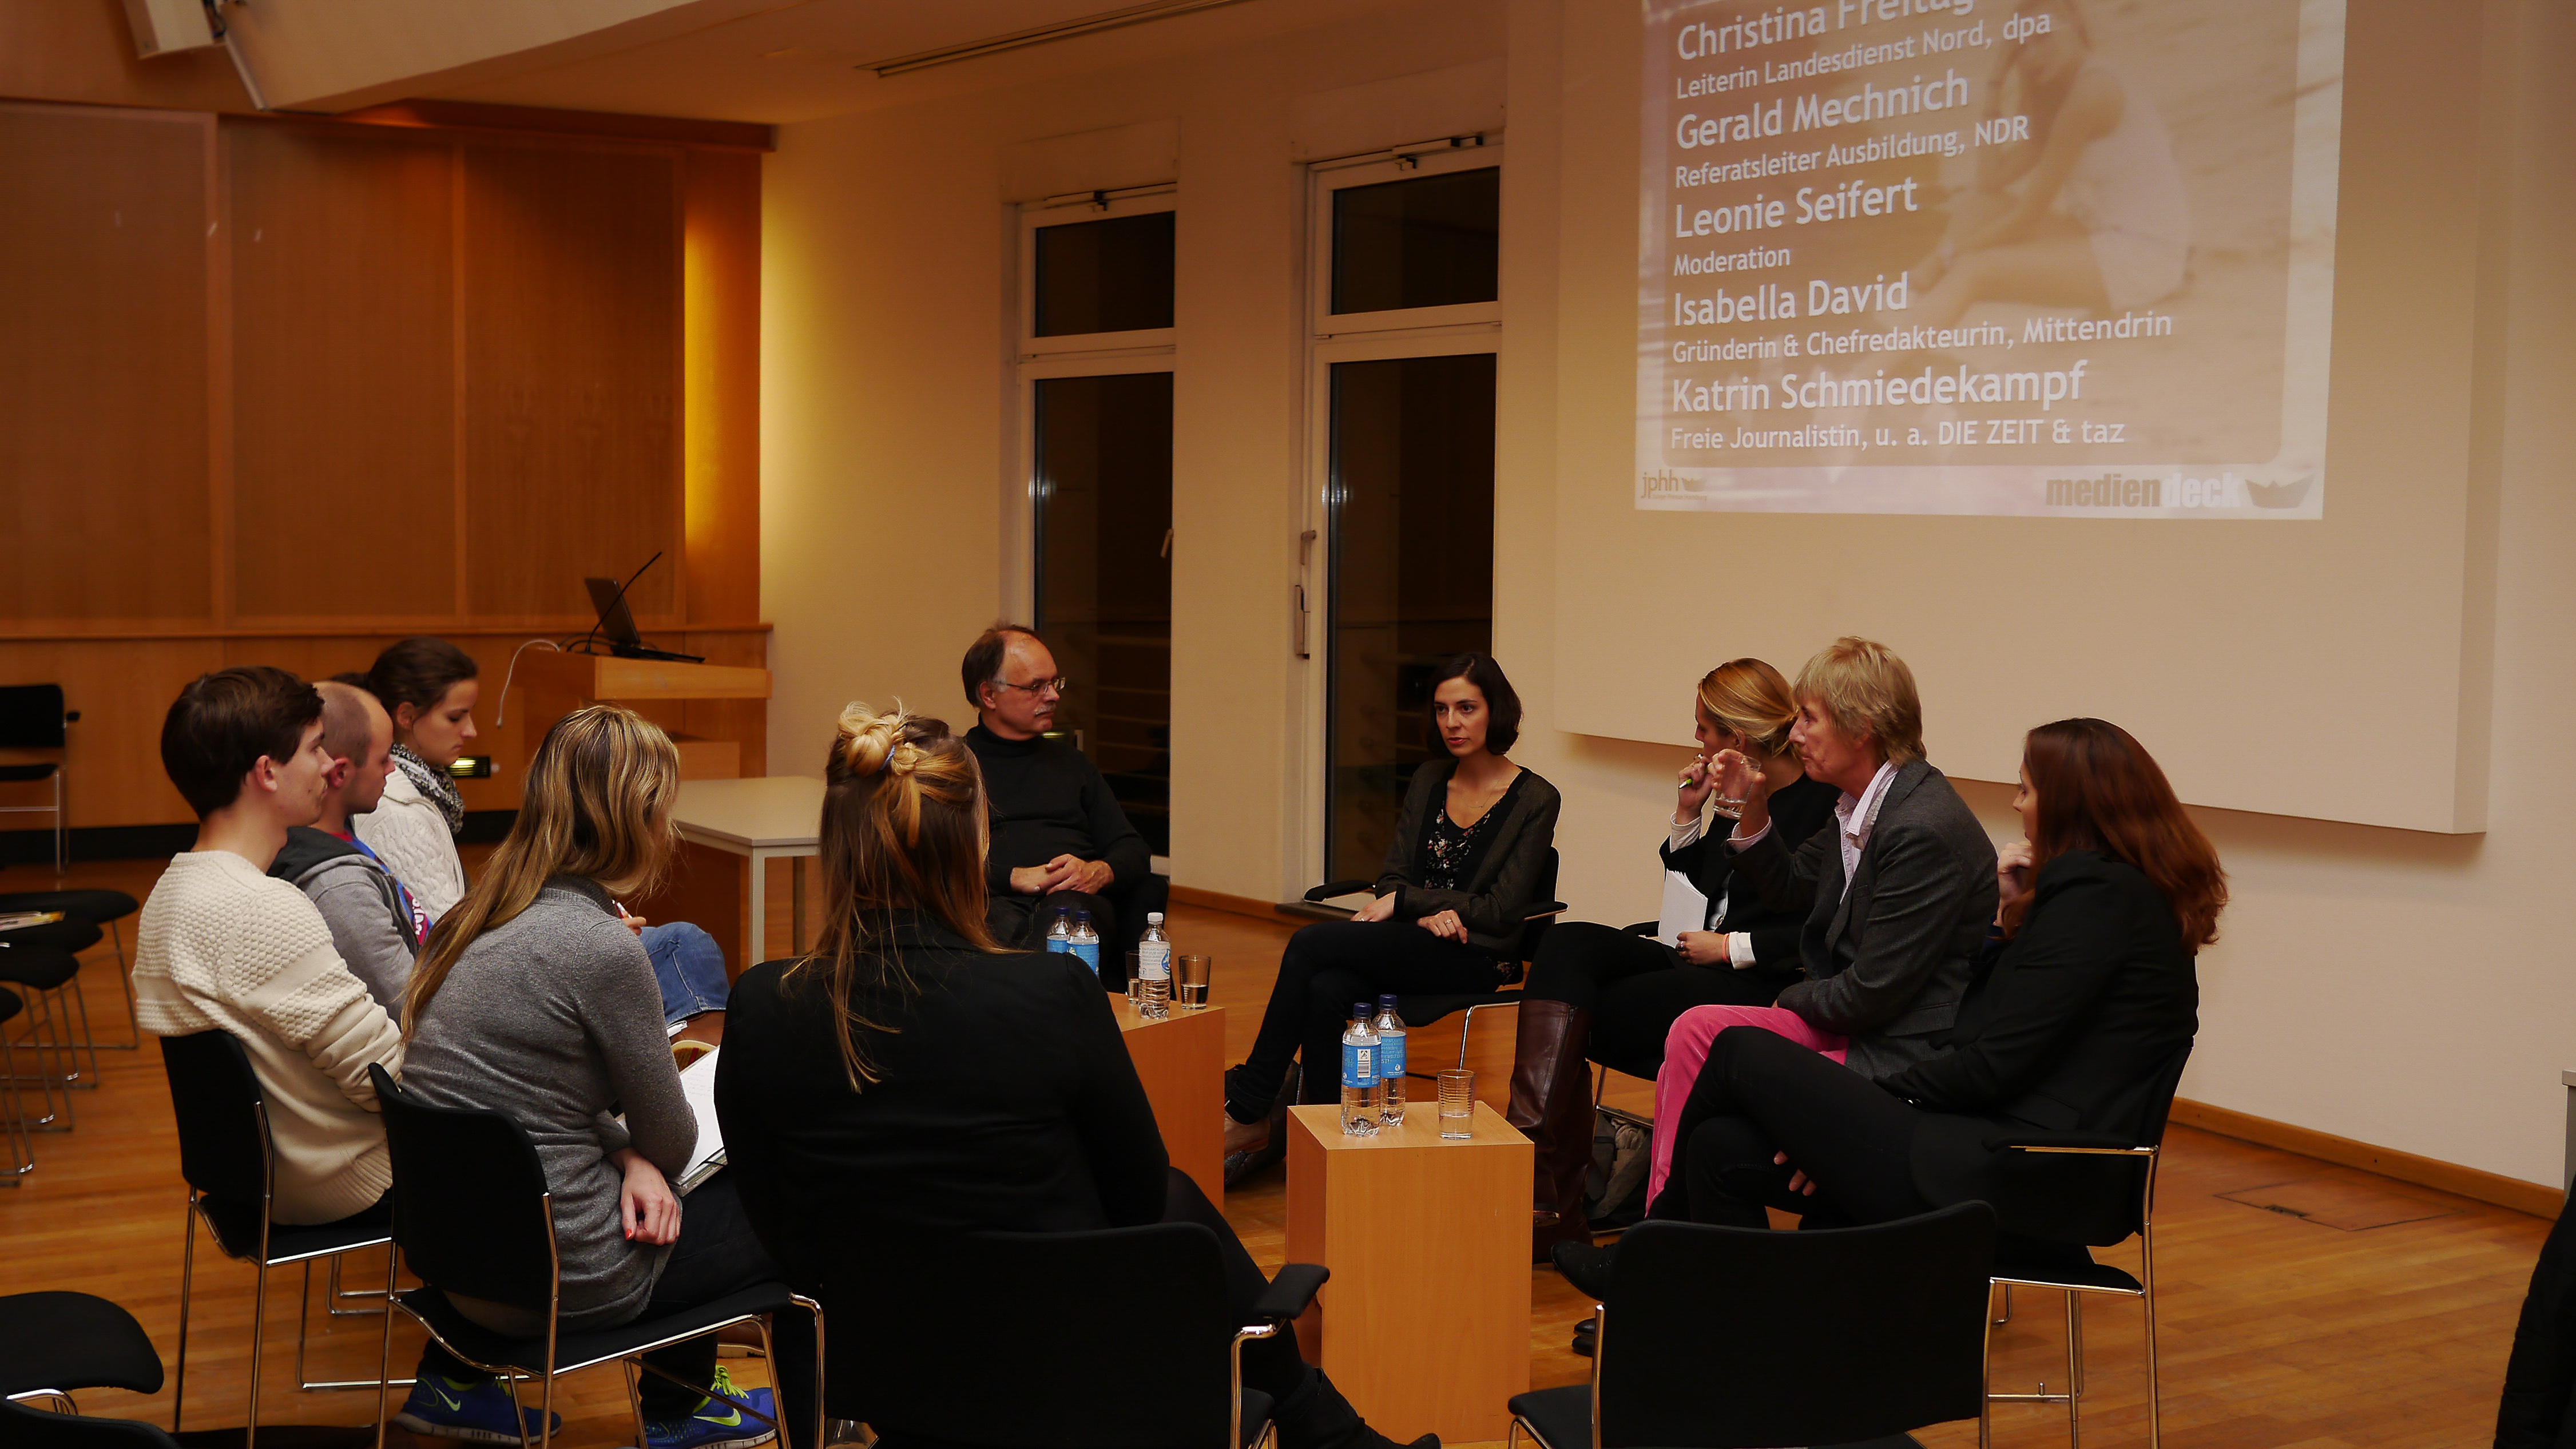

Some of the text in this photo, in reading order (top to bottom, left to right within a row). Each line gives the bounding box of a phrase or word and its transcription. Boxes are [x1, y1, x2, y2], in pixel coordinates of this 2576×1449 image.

[1677, 13, 2051, 99] Leiterin Landesdienst Nord, dpa
[1678, 7, 1826, 59] Christina
[1677, 68, 1968, 149] Gerald Mechnich
[1676, 116, 2030, 188] Referatsleiter Ausbildung, NDR
[1676, 177, 1918, 238] Leonie Seifert
[1673, 246, 1791, 276] Moderation
[1674, 271, 1908, 326] Isabella David
[1673, 311, 2172, 363] Gründerin & Chefredakteurin, Mittendrin
[1673, 359, 2088, 412] Katrin Schmiedekampf
[1671, 419, 2126, 451] Freie Journalistin, u. a. DIE ZEIT & taz
[1641, 469, 1679, 499] jphh
[2045, 473, 2242, 508] mediendeck
